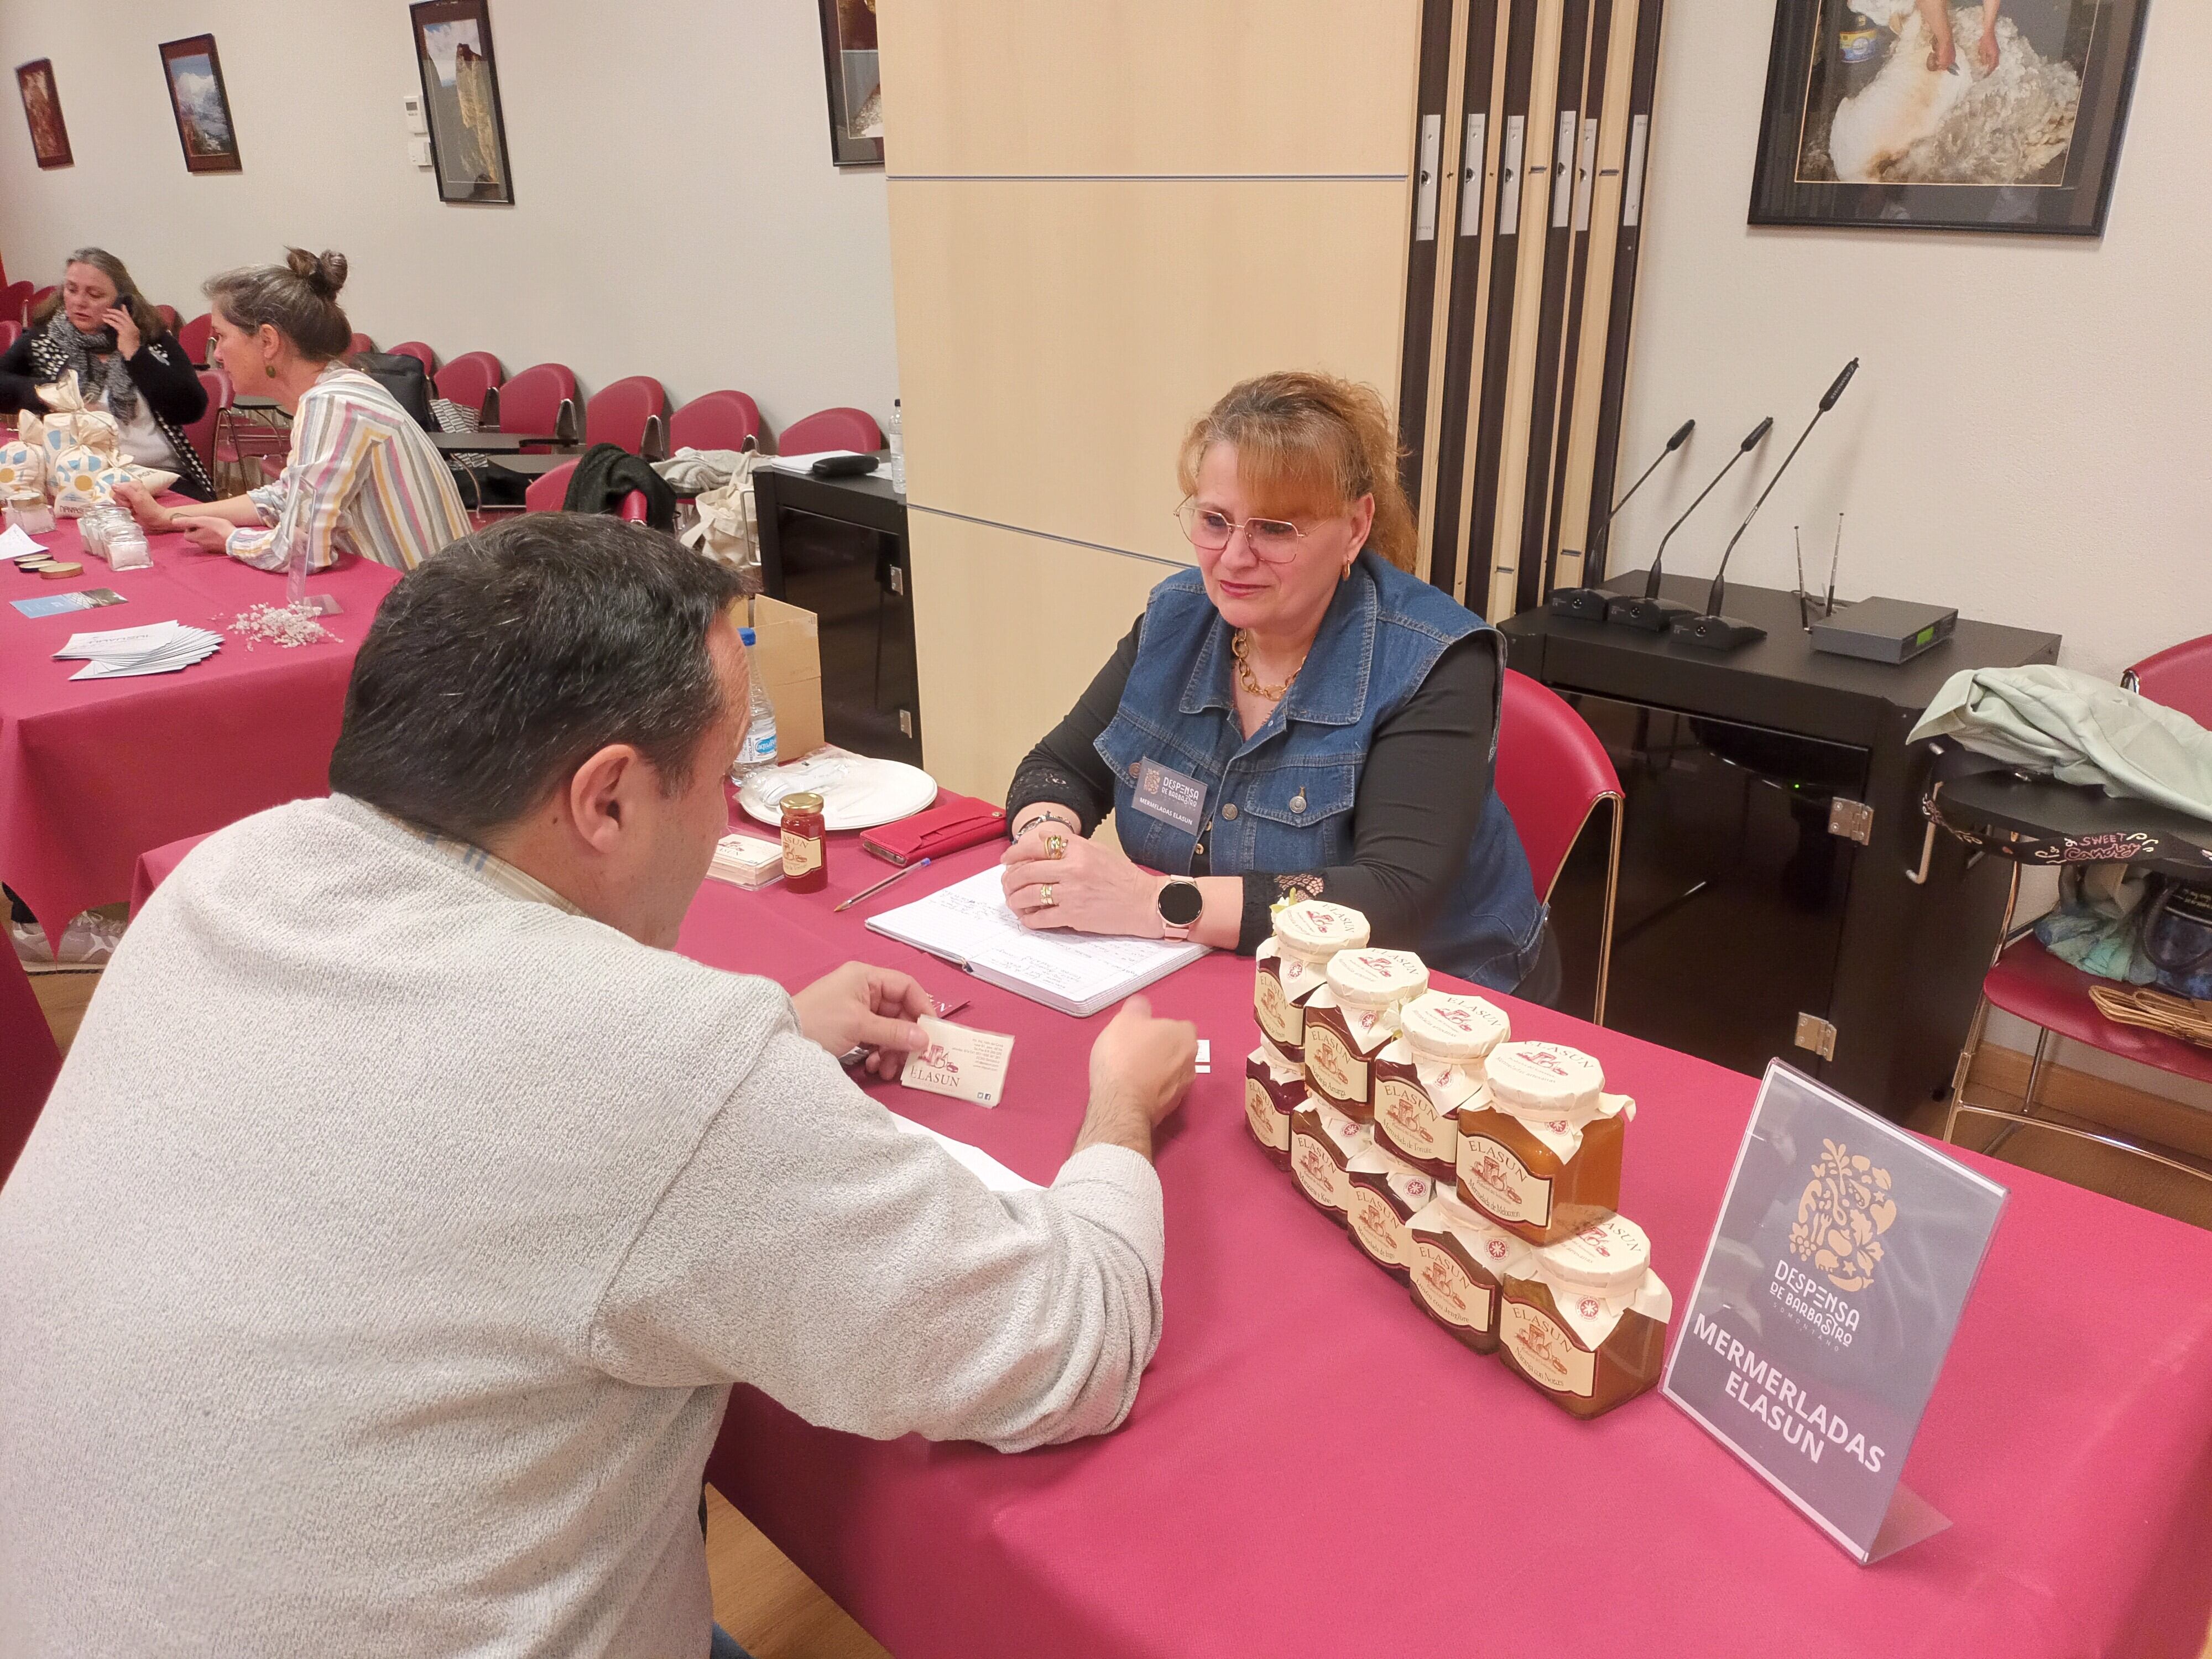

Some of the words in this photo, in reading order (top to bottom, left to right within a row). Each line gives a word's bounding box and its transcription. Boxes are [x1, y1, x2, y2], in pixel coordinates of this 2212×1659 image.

[1163, 777, 1199, 800] DESPENSA
[1168, 790, 1197, 807] BARBASTRO
[1140, 797, 1172, 816] MERMELADAS
[1173, 812, 1193, 826] ELASUN
[2079, 832, 2127, 846] SWEET
[1260, 976, 1288, 1010] ELASUN
[1447, 997, 1502, 1026] ELASUN
[1311, 1031, 1350, 1064] ELASUN
[911, 1065, 960, 1087] ELASUN
[1249, 1082, 1275, 1115] ELASUN
[1384, 1085, 1438, 1122] ELASUN
[1297, 1138, 1337, 1173] ELASUN
[1469, 1140, 1528, 1182] ELASUN
[1356, 1191, 1399, 1229] ELASUN
[1602, 1222, 1642, 1253] ASUN
[1420, 1247, 1469, 1289] ELASUN
[1775, 1260, 1860, 1331] DESPENSA
[1512, 1307, 1573, 1353] ELASUN
[1770, 1281, 1785, 1300] DE
[1785, 1292, 1853, 1347] BARBASTRO
[1773, 1302, 1839, 1351] SOMONTANO
[1693, 1313, 1885, 1472] MERMERLADAS
[1725, 1371, 1824, 1463] ELASUN
